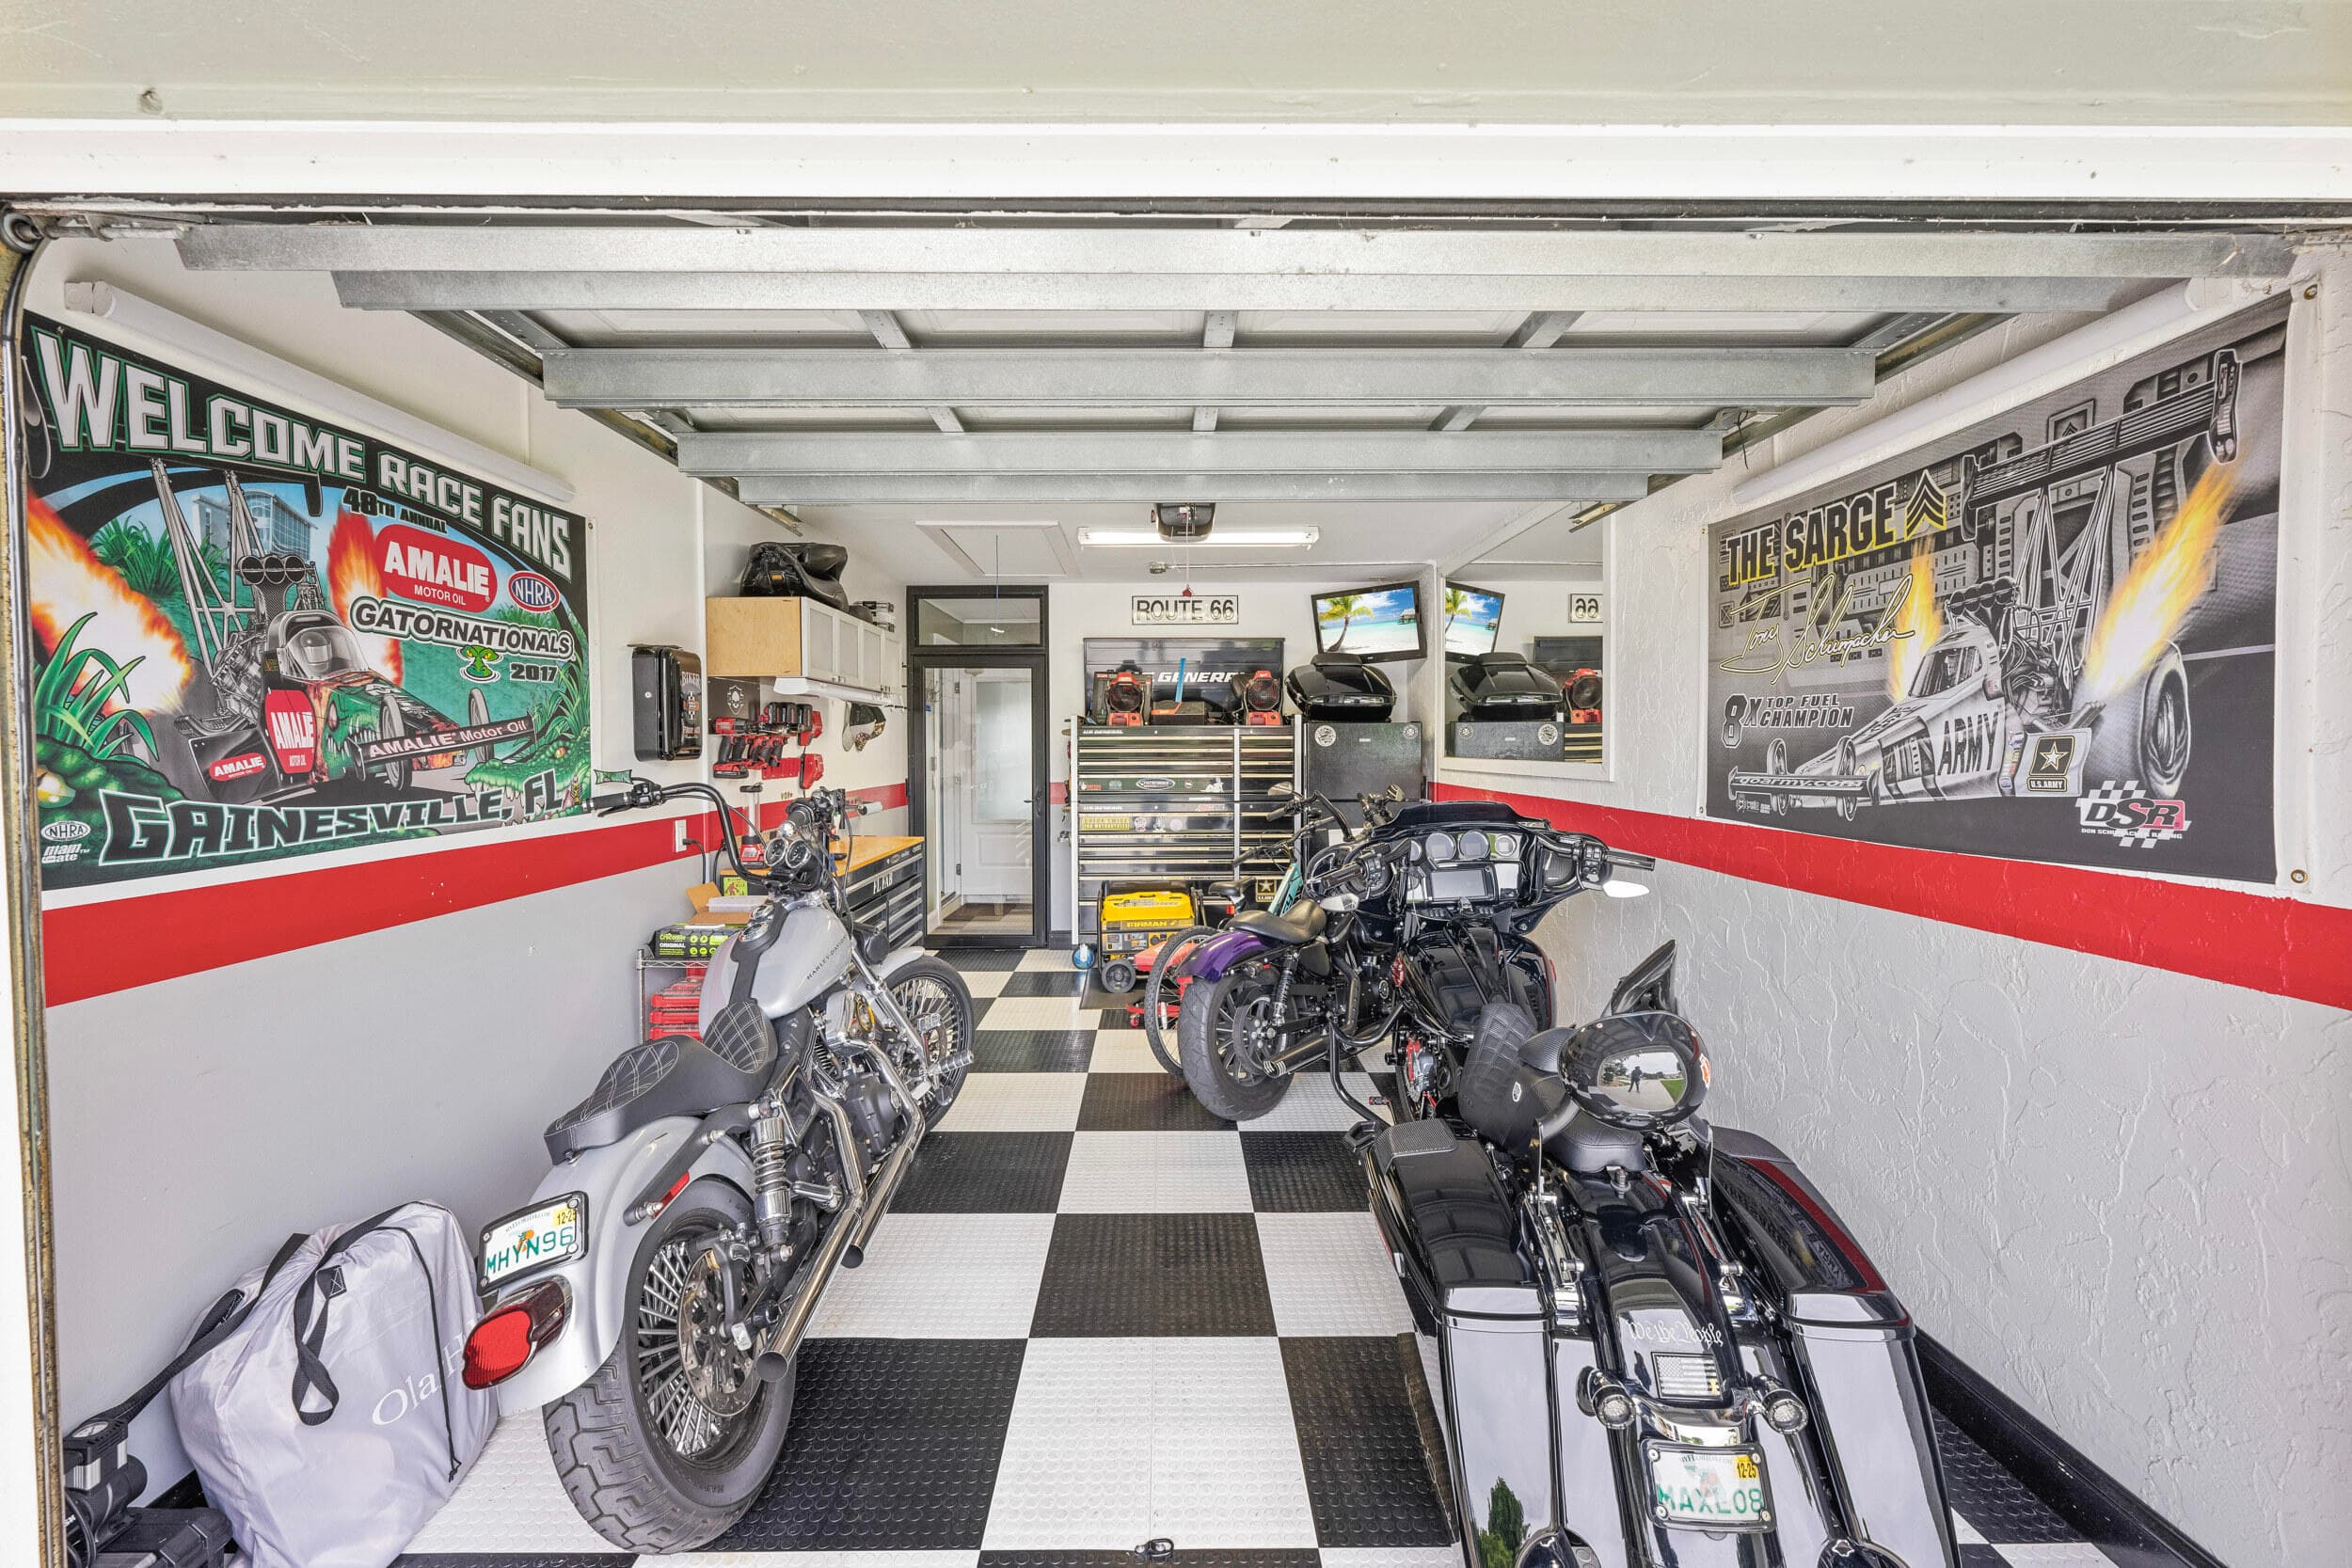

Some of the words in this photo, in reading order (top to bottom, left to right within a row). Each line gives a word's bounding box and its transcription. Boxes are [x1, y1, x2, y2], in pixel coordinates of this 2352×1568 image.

[32, 326, 365, 482] WELCOME
[379, 451, 483, 531] RACE
[492, 495, 571, 581] FANS
[343, 487, 395, 517] 48TH
[400, 505, 447, 533] ANNUAL
[1726, 526, 1775, 586] THE
[1785, 482, 1898, 572] SARGE
[384, 542, 489, 597] AMALIE
[415, 584, 451, 601] MOTOR
[453, 594, 467, 606] OIL
[516, 577, 553, 604] NHRA
[1136, 600, 1203, 621] ROUTE
[1211, 599, 1234, 621] 66
[356, 603, 570, 655] GATORNATIONALS
[510, 663, 558, 682] 2017
[681, 671, 701, 689] BIKER
[1158, 672, 1245, 683] GENERA
[1767, 696, 1794, 708] TOP
[1801, 694, 1839, 707] FUEL
[271, 712, 314, 749] AMALIE
[1722, 694, 1762, 748] 8X
[1759, 707, 1853, 728] CHAMPION
[369, 732, 455, 758] AMALIE
[460, 725, 503, 742] Motor
[507, 719, 527, 733] Oil
[1938, 711, 2000, 776] ARMY
[215, 756, 263, 776] AMALIE
[1740, 776, 1864, 788] goarmy.com
[98, 788, 515, 866] GAINESVILLE,
[522, 768, 565, 816] FL
[2084, 798, 2181, 830] DSR
[49, 824, 84, 838] NHRA
[485, 1226, 573, 1277] MHYN96
[1629, 1322, 1652, 1341] We
[1677, 1320, 1724, 1349] People
[372, 1372, 439, 1426] Ola
[1736, 1458, 1756, 1479] 12-25
[1656, 1483, 1763, 1514] MAXL08
